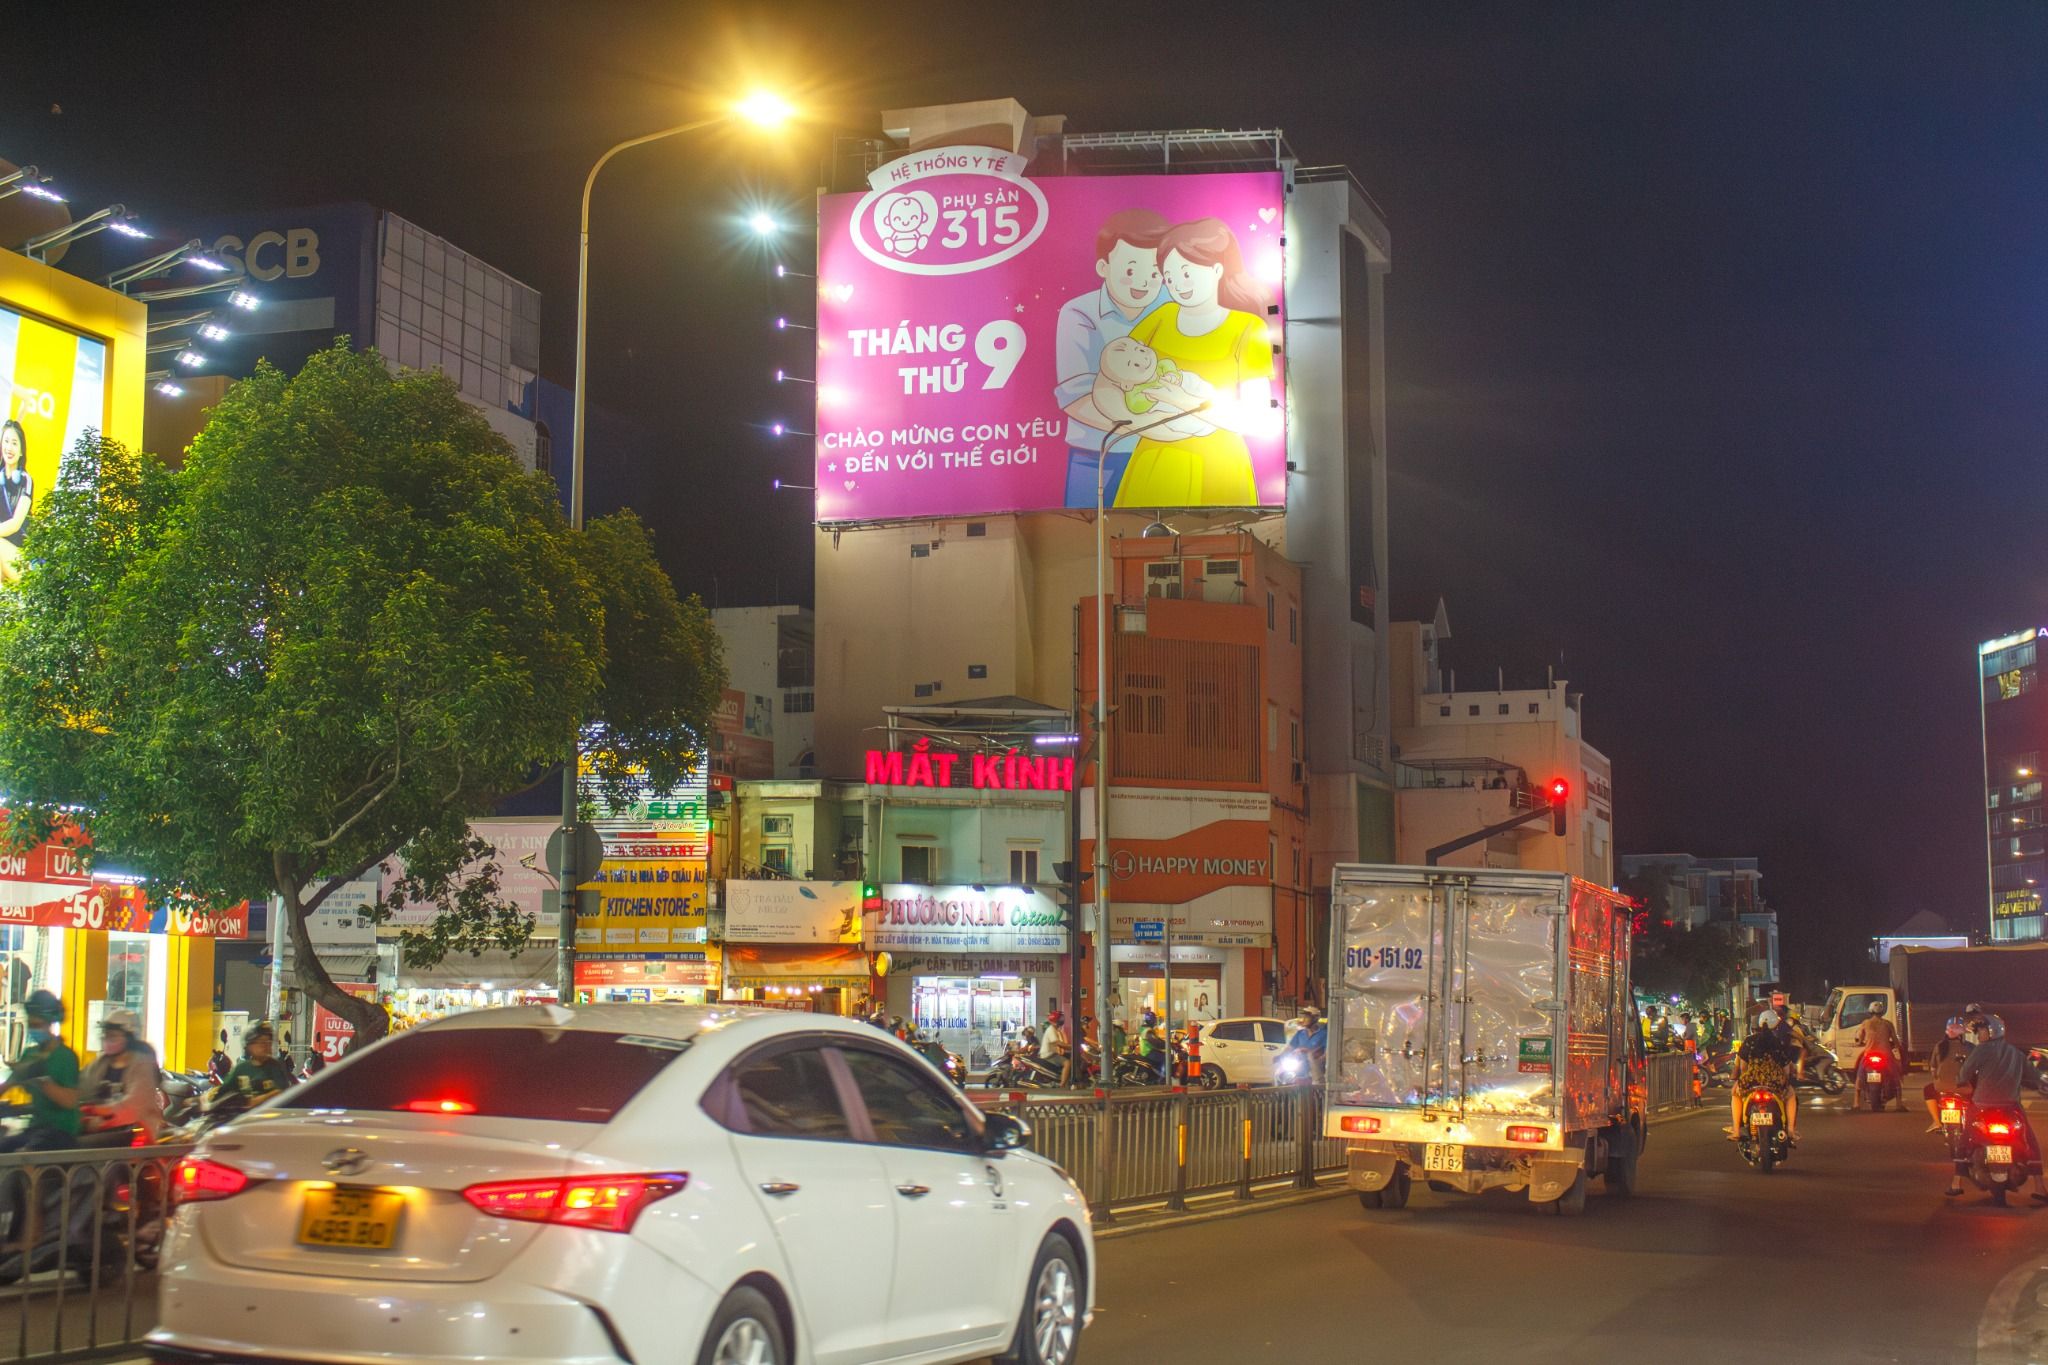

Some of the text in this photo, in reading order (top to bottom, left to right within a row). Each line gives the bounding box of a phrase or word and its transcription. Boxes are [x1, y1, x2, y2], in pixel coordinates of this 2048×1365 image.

[890, 152, 1007, 181] HỆ THỐNG Y TẾ
[942, 187, 1020, 208] PHỤ SẢN
[941, 206, 1021, 249] 315
[214, 228, 320, 281] SCB
[848, 320, 1027, 390] THÁNG 9
[899, 358, 968, 395] THỨ
[823, 416, 1061, 450] CHÀO MỪNG CON YÊU
[845, 443, 1038, 474] ĐẾN VỚI THẾ GIỚI
[865, 736, 1075, 791] MẮT KÍNH
[1139, 857, 1267, 876] HAPPY MONEY
[607, 898, 652, 917] KITCHEN
[877, 895, 1064, 932] PHƯƠNG NAM Optical
[1434, 1145, 1455, 1158] 61C
